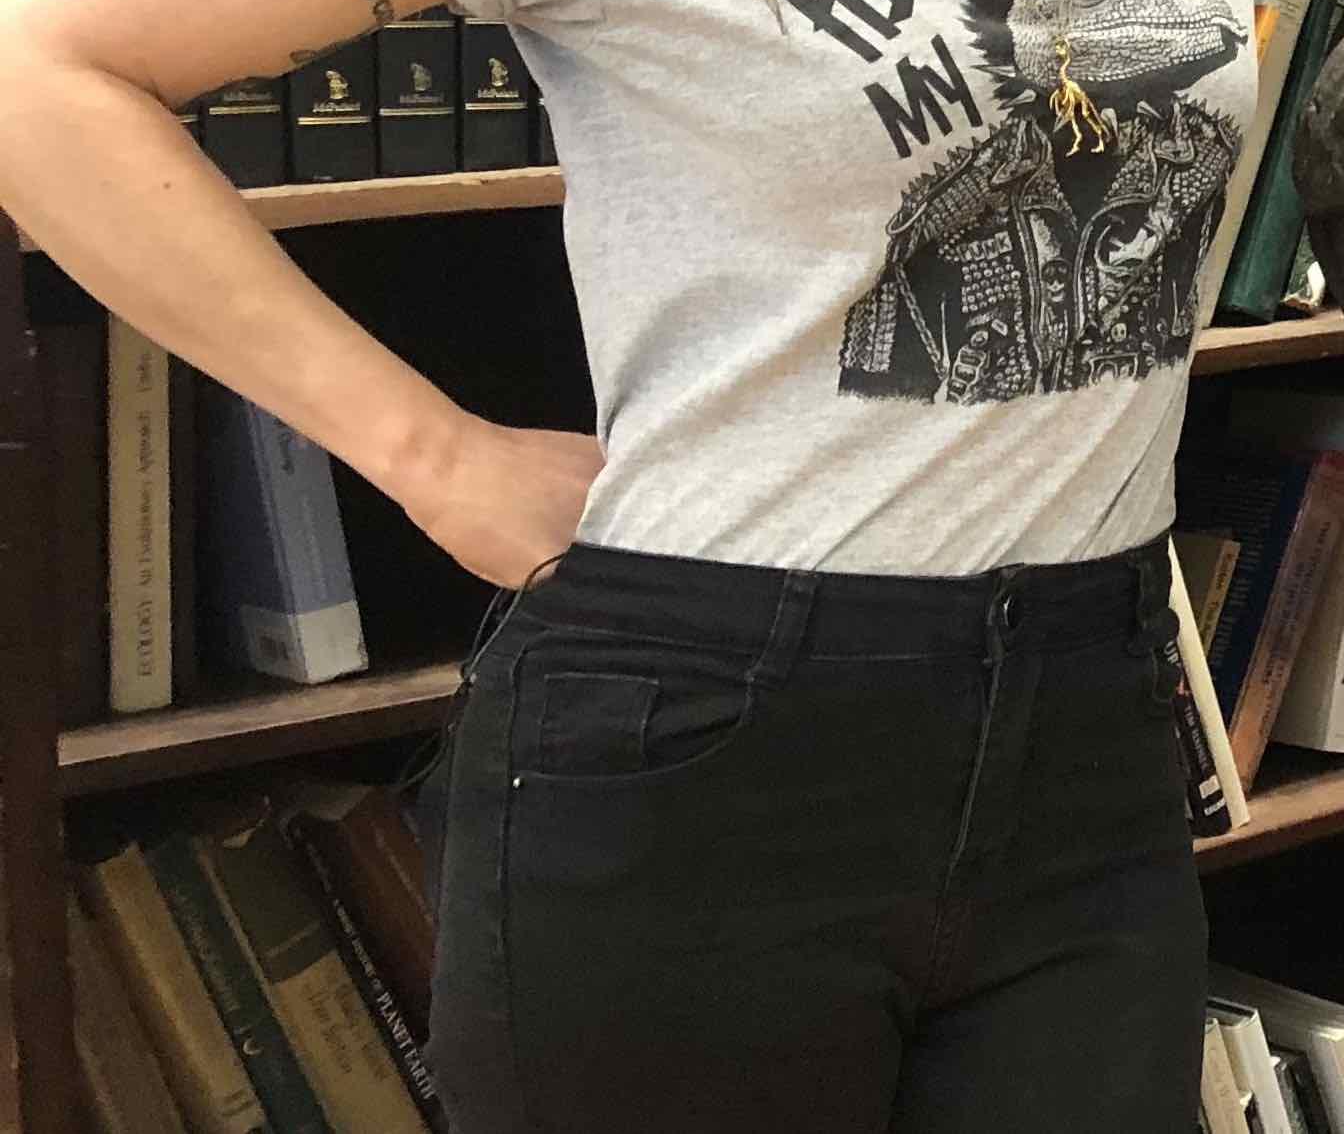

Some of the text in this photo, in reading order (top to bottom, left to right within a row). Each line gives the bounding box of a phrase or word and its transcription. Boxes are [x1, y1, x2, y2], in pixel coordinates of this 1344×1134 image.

[862, 33, 983, 159] MY
[375, 990, 414, 1051] PLANET
[403, 1046, 437, 1102] EARTH
